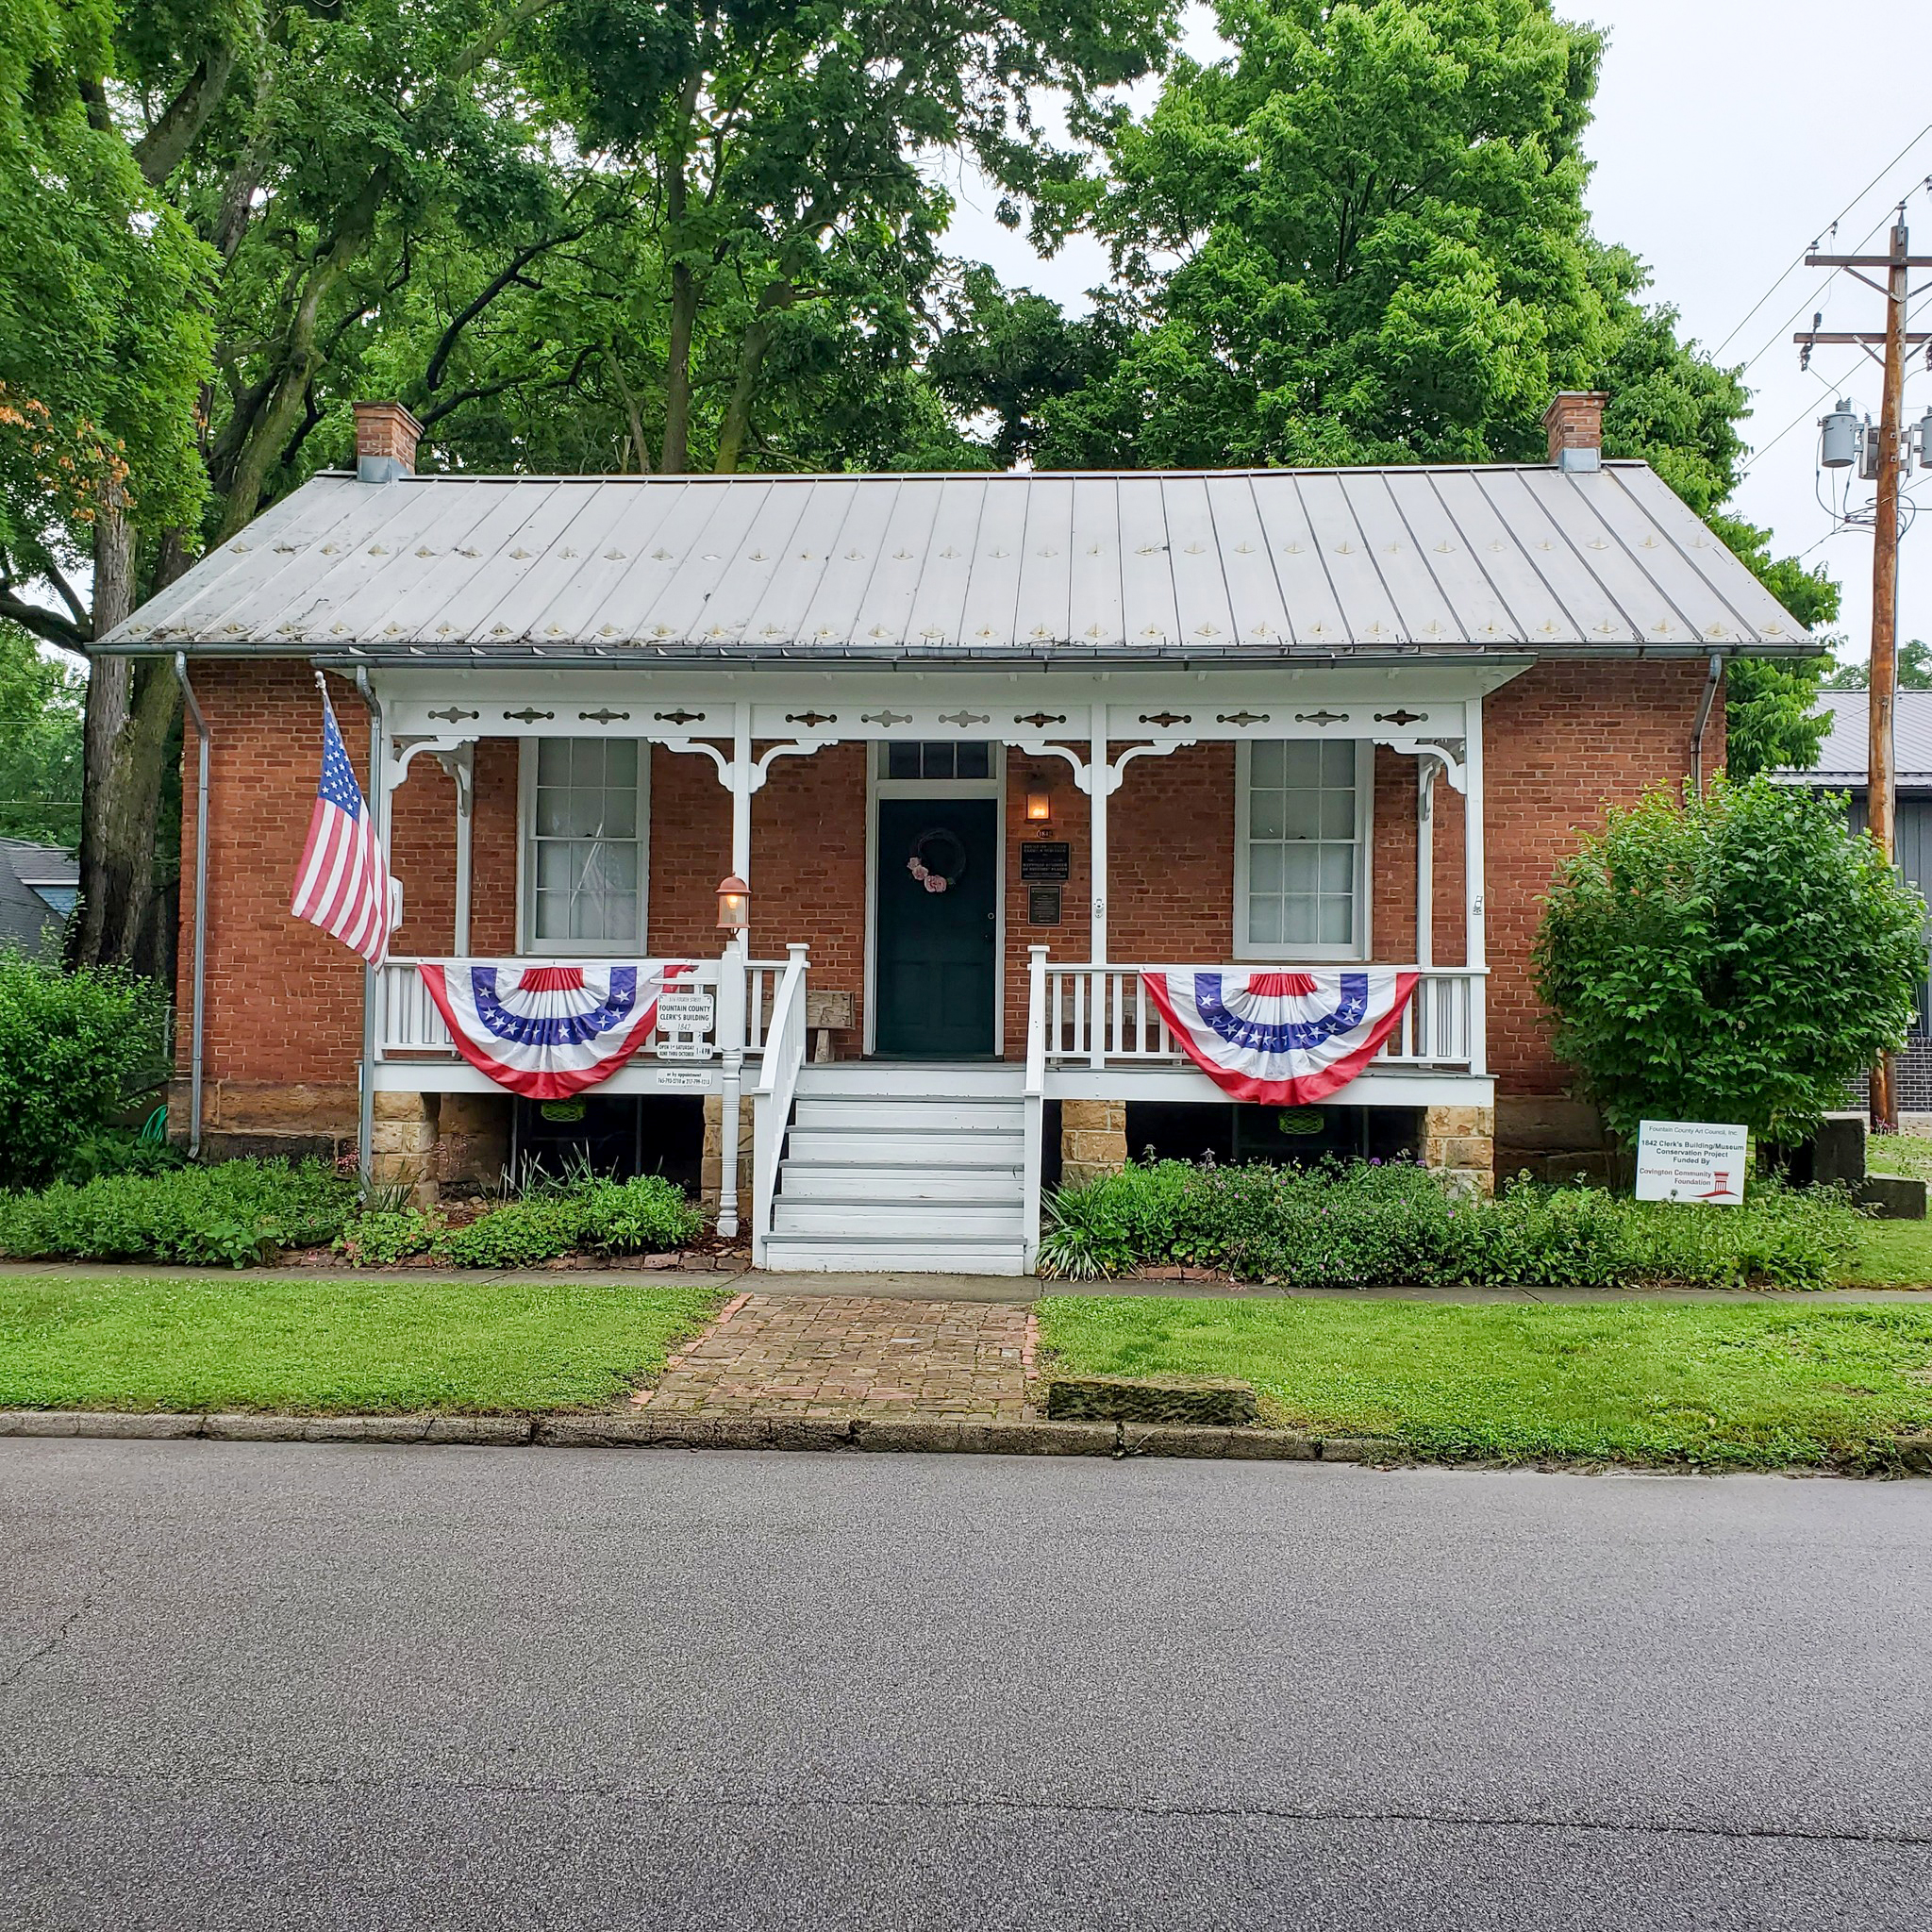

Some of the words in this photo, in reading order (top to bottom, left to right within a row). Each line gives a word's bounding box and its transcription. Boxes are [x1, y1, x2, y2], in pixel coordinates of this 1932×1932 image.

[1684, 1142, 1744, 1150] Building/Museum
[1656, 1148, 1702, 1156] Conservation
[1674, 1169, 1712, 1178] Community
